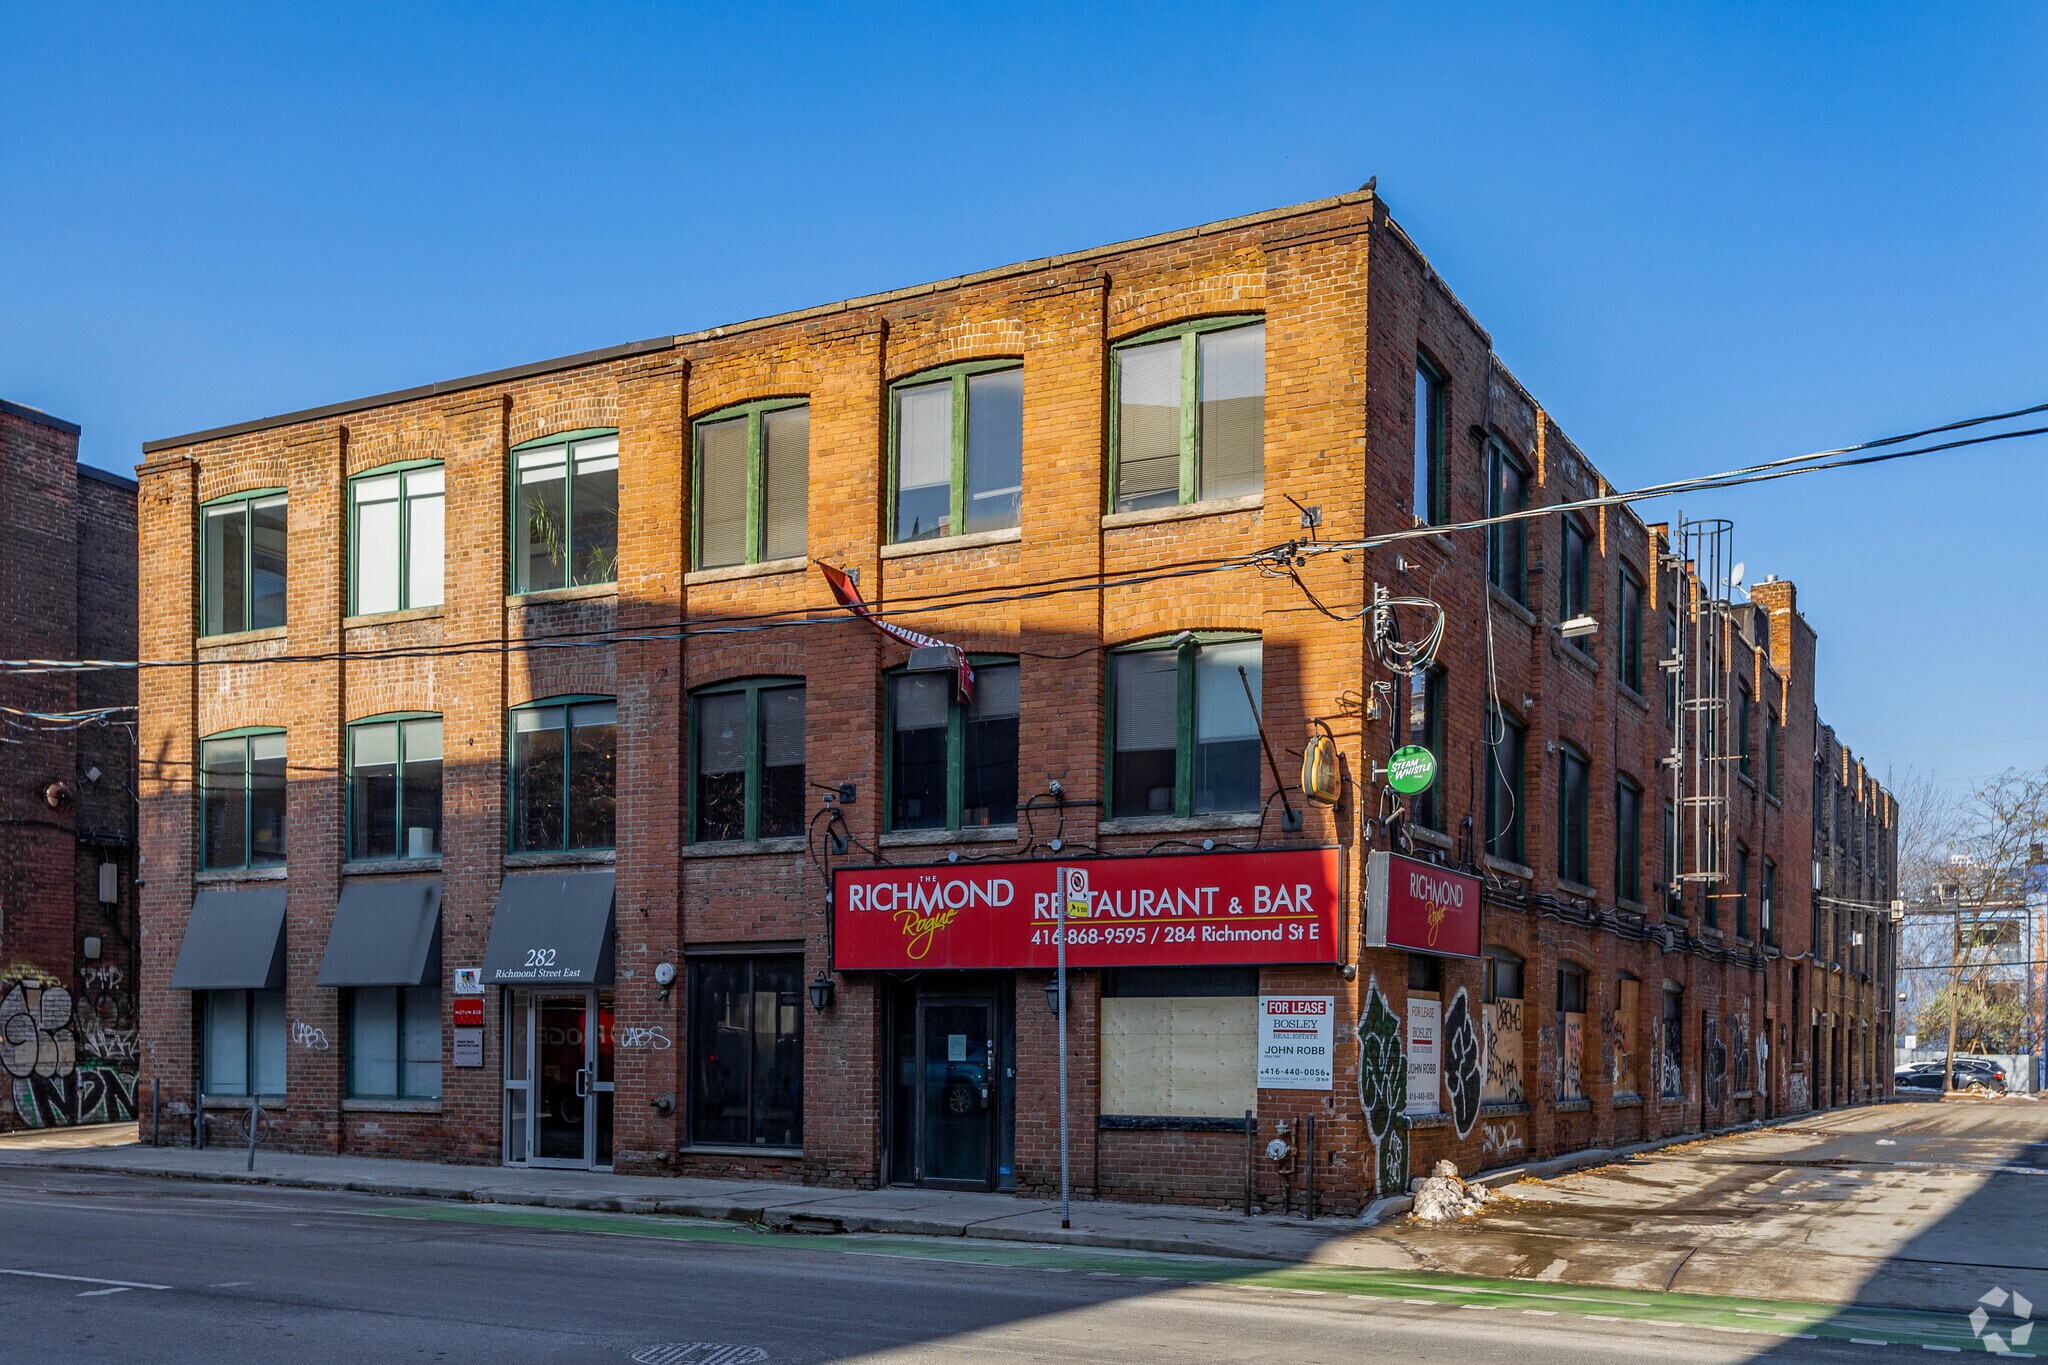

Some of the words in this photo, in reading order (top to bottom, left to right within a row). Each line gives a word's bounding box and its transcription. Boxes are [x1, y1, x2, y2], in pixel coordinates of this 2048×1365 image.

[1391, 758, 1419, 773] STEAM
[1395, 762, 1432, 780] WHISTLE
[919, 875, 937, 883] THE
[1410, 872, 1464, 909] RICHMOND
[849, 879, 1015, 917] RICHMOND
[1034, 886, 1220, 919] RETAURANT
[1228, 896, 1243, 915] &
[1254, 883, 1314, 914] BAR
[893, 908, 958, 960] Rogue
[1164, 925, 1196, 943] 284
[1202, 923, 1283, 942] Richmond
[1288, 923, 1304, 940] St
[1309, 923, 1319, 940] E
[524, 948, 557, 967] 282
[495, 969, 537, 979] Richmond
[538, 968, 562, 978] Street
[562, 968, 581, 977] East
[1269, 1001, 1289, 1014] FOR
[1292, 1001, 1325, 1014] LEASE
[1411, 1005, 1421, 1018] FOR
[1421, 1006, 1435, 1019] LEASE
[1273, 1019, 1318, 1029] BOSLEY
[1412, 1027, 1433, 1039] BOSLEY
[1264, 1046, 1294, 1055] JOHN
[1296, 1046, 1326, 1056] ROBB
[1264, 1068, 1326, 1077] 416-440-0056
[1408, 1063, 1422, 1074] JOHN
[1422, 1063, 1437, 1075] ROBB
